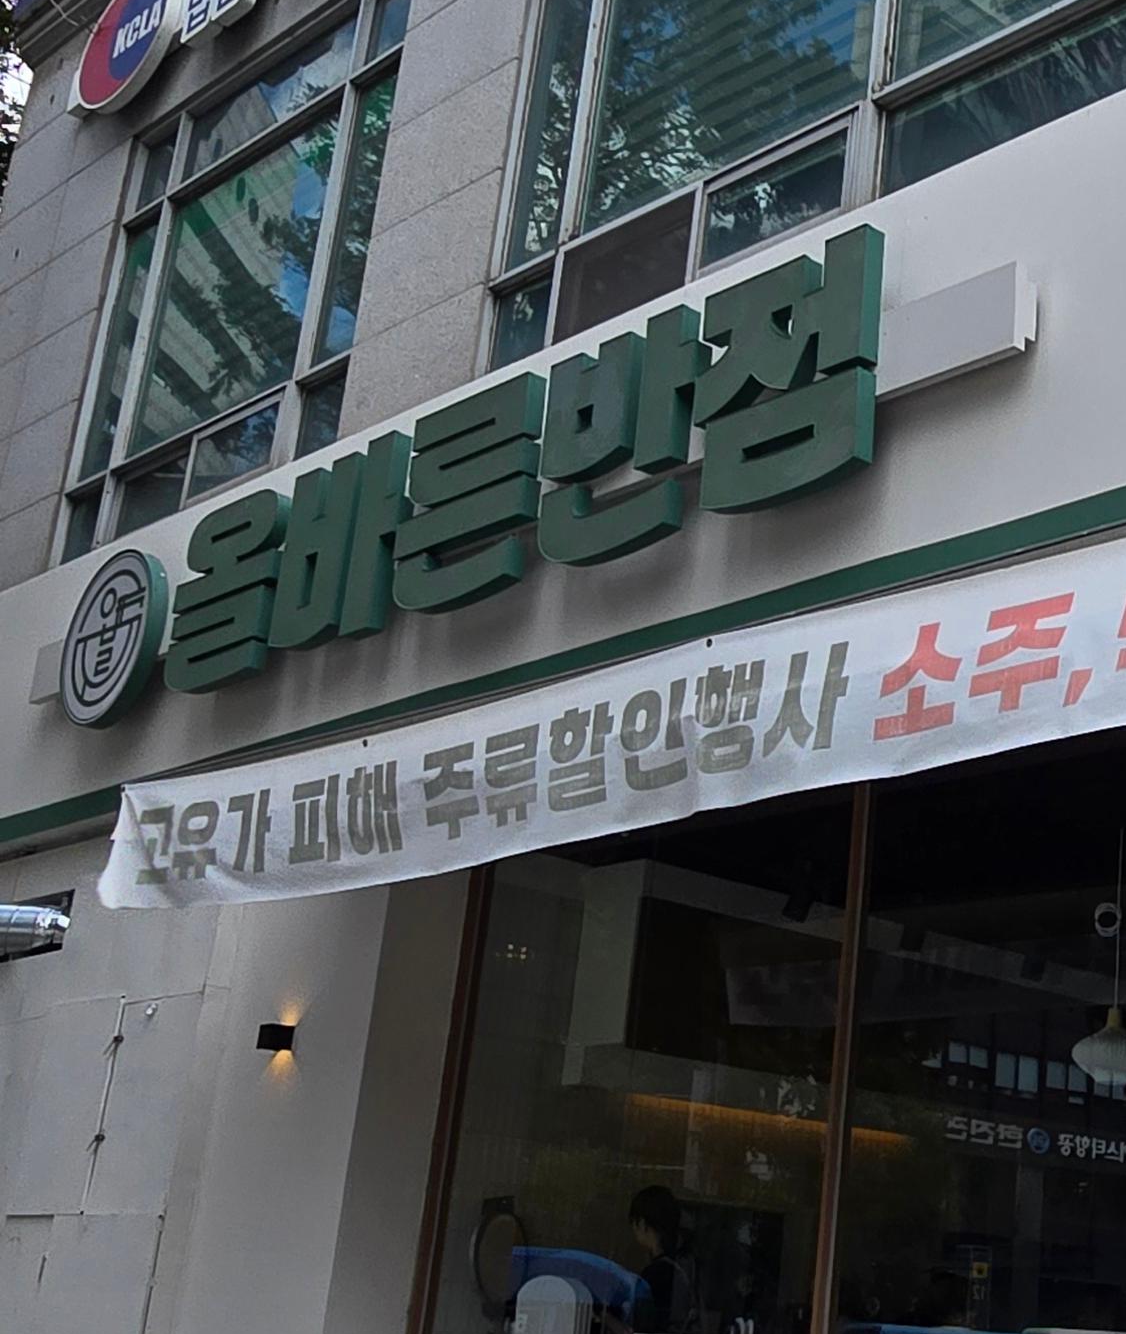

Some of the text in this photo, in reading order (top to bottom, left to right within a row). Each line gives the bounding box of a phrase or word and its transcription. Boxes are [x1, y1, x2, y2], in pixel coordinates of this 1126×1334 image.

[165, 223, 884, 693] 올바른반점
[135, 787, 272, 885] 고유가
[289, 759, 403, 865] 피해
[423, 640, 849, 840] 주류할인행사
